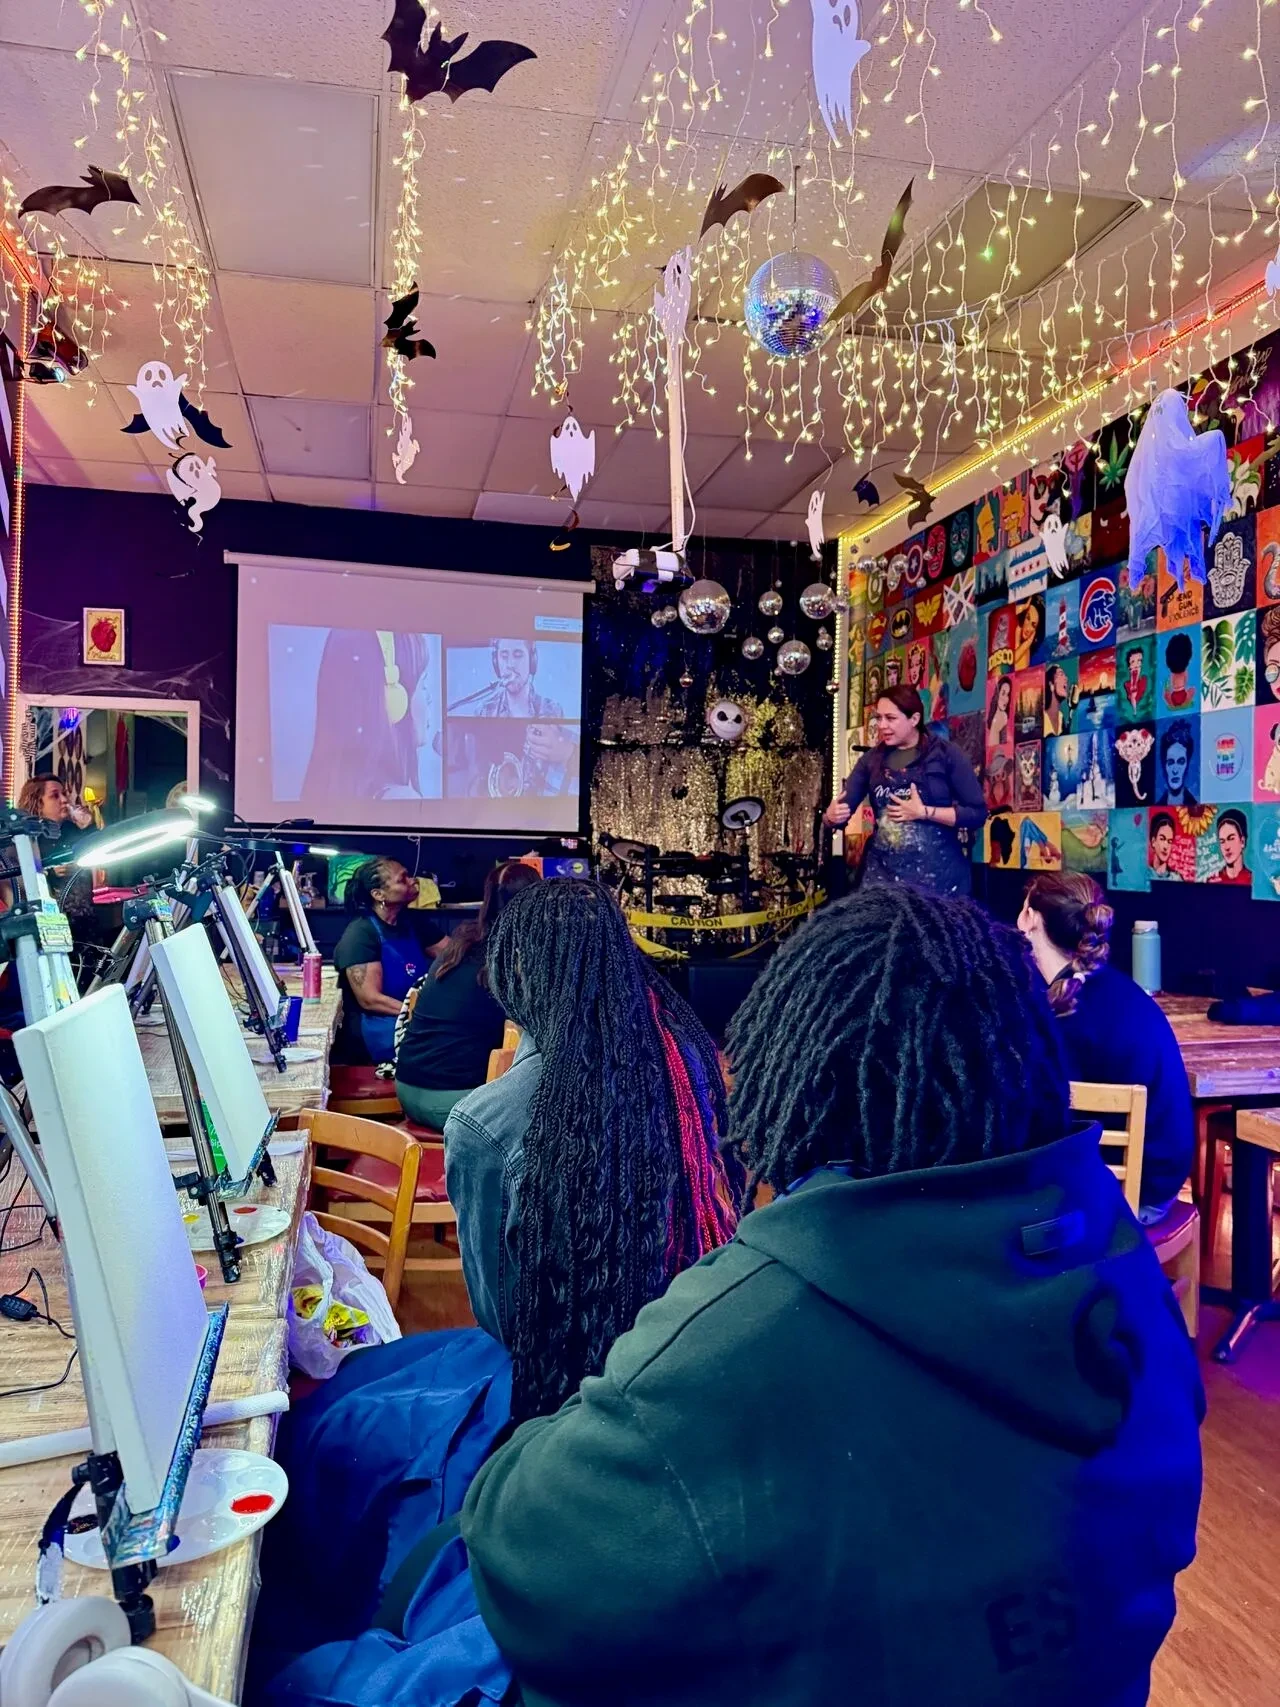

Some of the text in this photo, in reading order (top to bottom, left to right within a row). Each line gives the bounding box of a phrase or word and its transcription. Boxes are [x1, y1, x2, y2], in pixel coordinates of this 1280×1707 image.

[1177, 590, 1193, 601] END
[1178, 600, 1193, 611] GUN
[988, 648, 1014, 671] DISCO
[1216, 762, 1235, 775] LOVE
[670, 915, 724, 928] CAUTION
